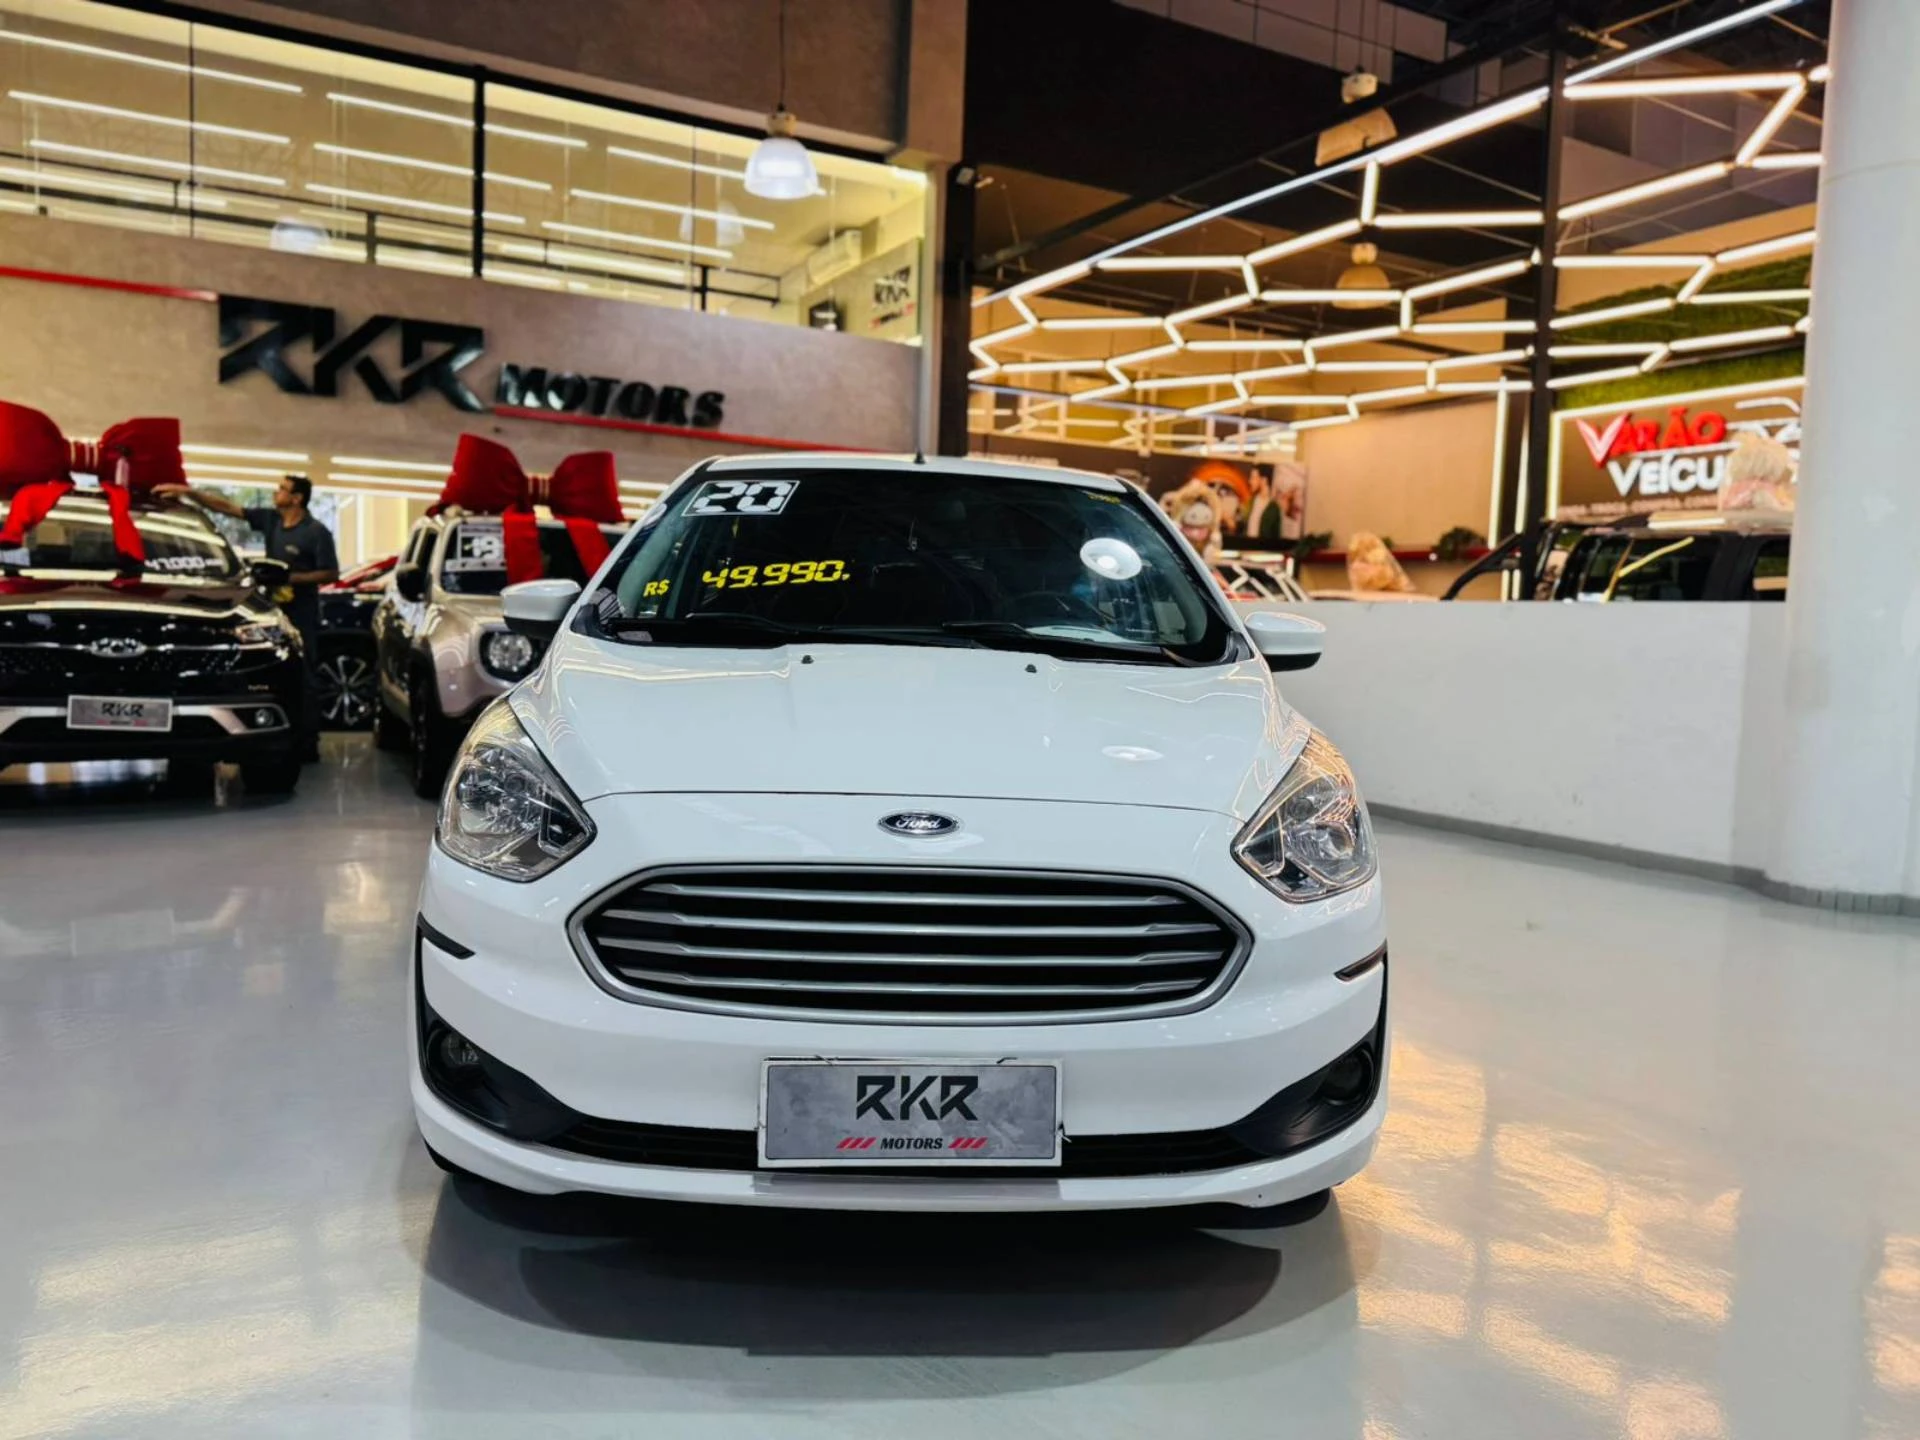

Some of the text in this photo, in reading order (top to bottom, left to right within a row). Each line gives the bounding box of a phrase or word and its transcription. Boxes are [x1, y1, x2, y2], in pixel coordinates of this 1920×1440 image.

[218, 293, 726, 429] RKR MOTORS
[1575, 405, 1728, 468] VARÃO
[1606, 453, 1728, 497] VEÍCU
[692, 480, 793, 513] 20
[643, 579, 671, 598] R$
[101, 702, 144, 717] RKR
[895, 814, 941, 829] Ford
[856, 1075, 978, 1121] RKR
[880, 1137, 943, 1150] MOTORS
